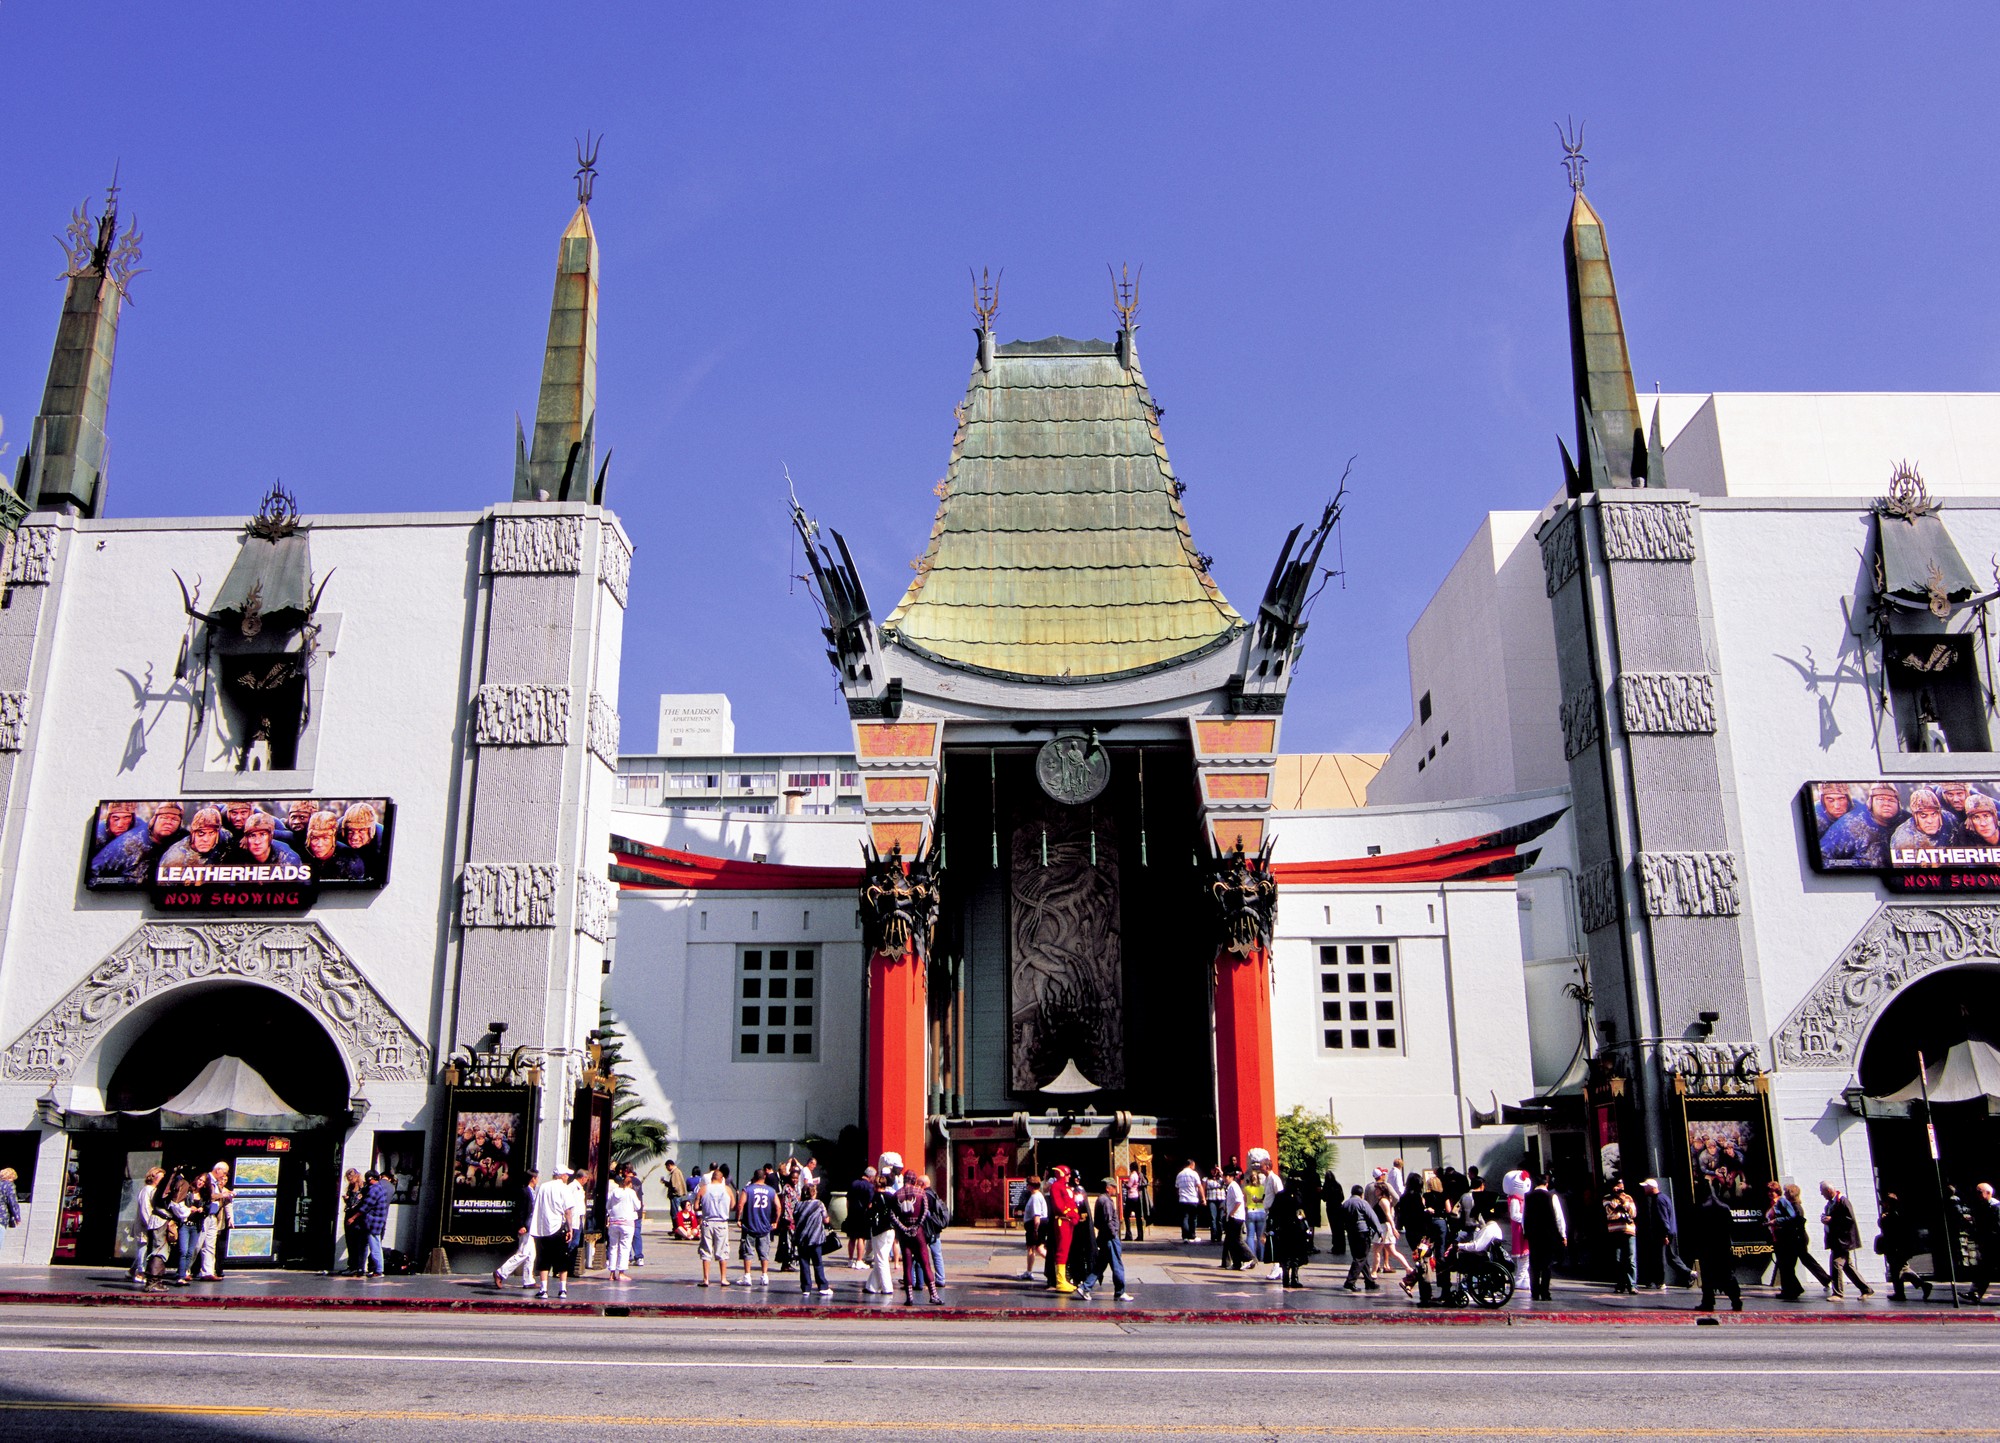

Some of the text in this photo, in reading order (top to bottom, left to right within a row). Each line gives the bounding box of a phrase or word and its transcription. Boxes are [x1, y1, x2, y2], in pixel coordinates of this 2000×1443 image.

[664, 708, 680, 716] THE
[156, 865, 311, 881] LEATHERHEADS
[1904, 874, 1941, 887] NOW
[165, 892, 299, 905] NOW SHOWING
[225, 1138, 267, 1147] GIFT SHOP
[453, 1199, 516, 1207] LEATHERHEADS
[753, 1194, 769, 1208] 23
